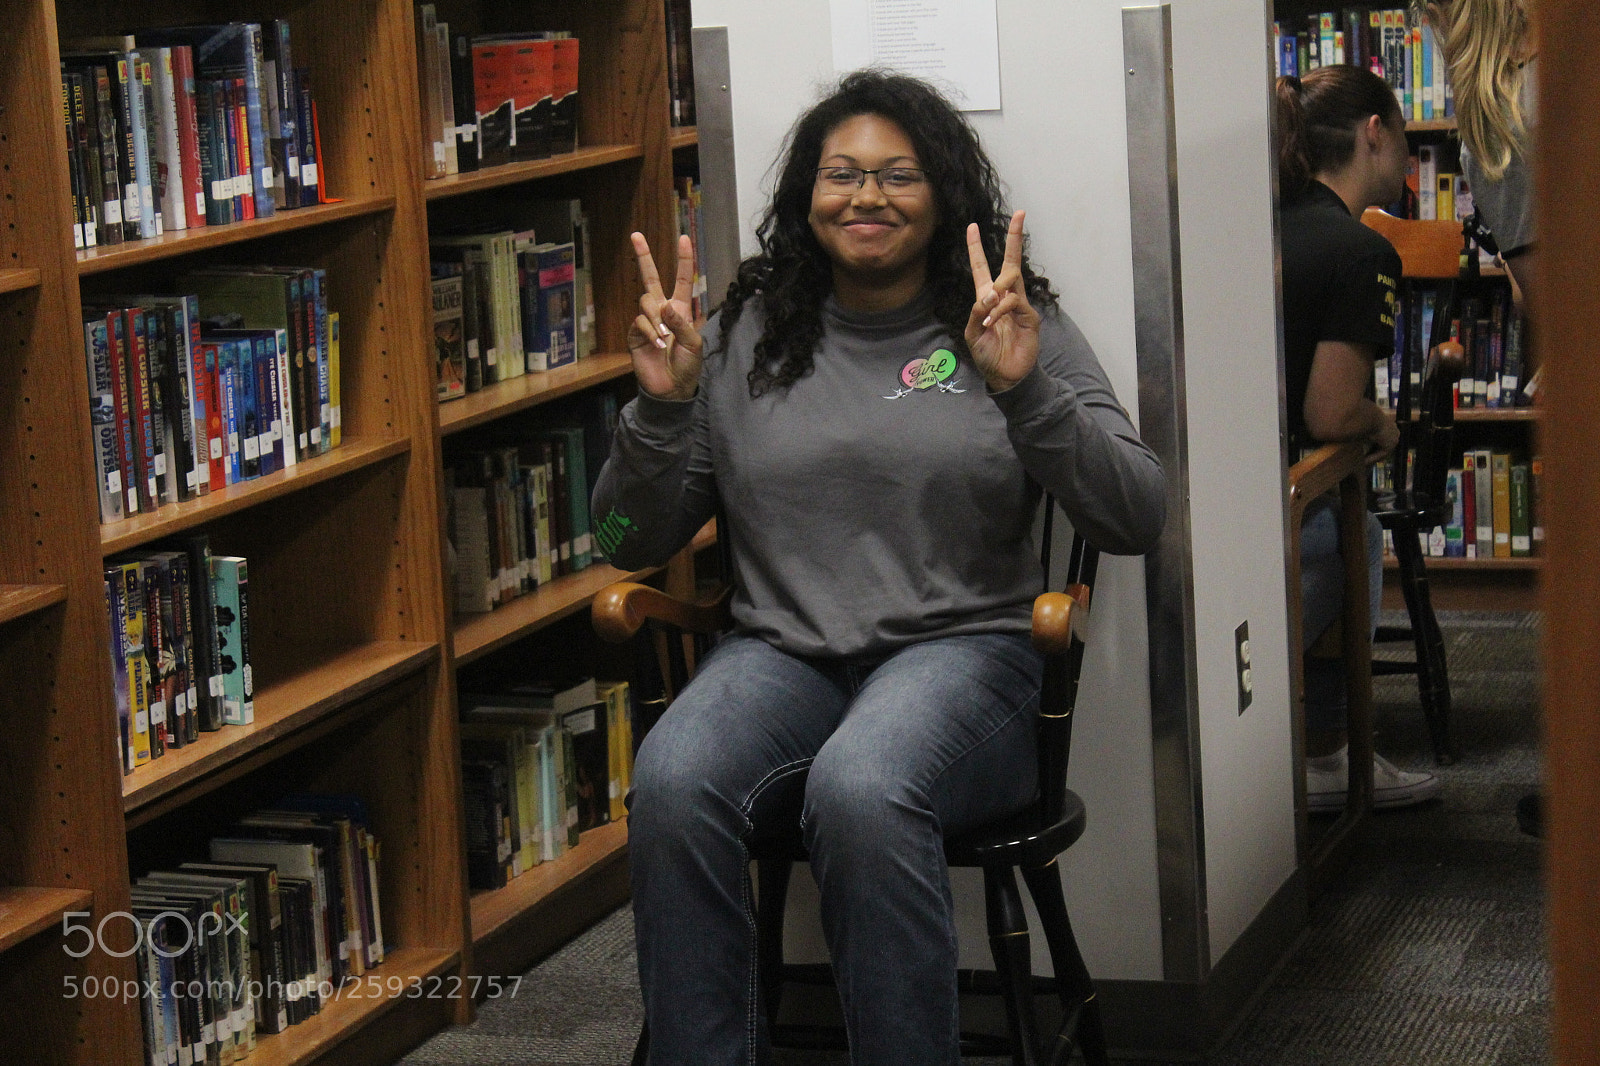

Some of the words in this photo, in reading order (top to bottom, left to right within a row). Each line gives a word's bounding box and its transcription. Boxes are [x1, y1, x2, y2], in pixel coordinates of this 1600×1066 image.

[73, 85, 83, 122] DELETE
[126, 133, 135, 167] BUCKING
[307, 301, 315, 344] CUSSLER
[138, 356, 150, 410] CUSSLER
[193, 346, 205, 402] CUSSLER
[320, 365, 328, 399] CHASE
[118, 358, 129, 413] CUSSLER
[127, 465, 135, 487] TID
[101, 428, 114, 491] ODYSS
[134, 661, 143, 706] PLAGUE
